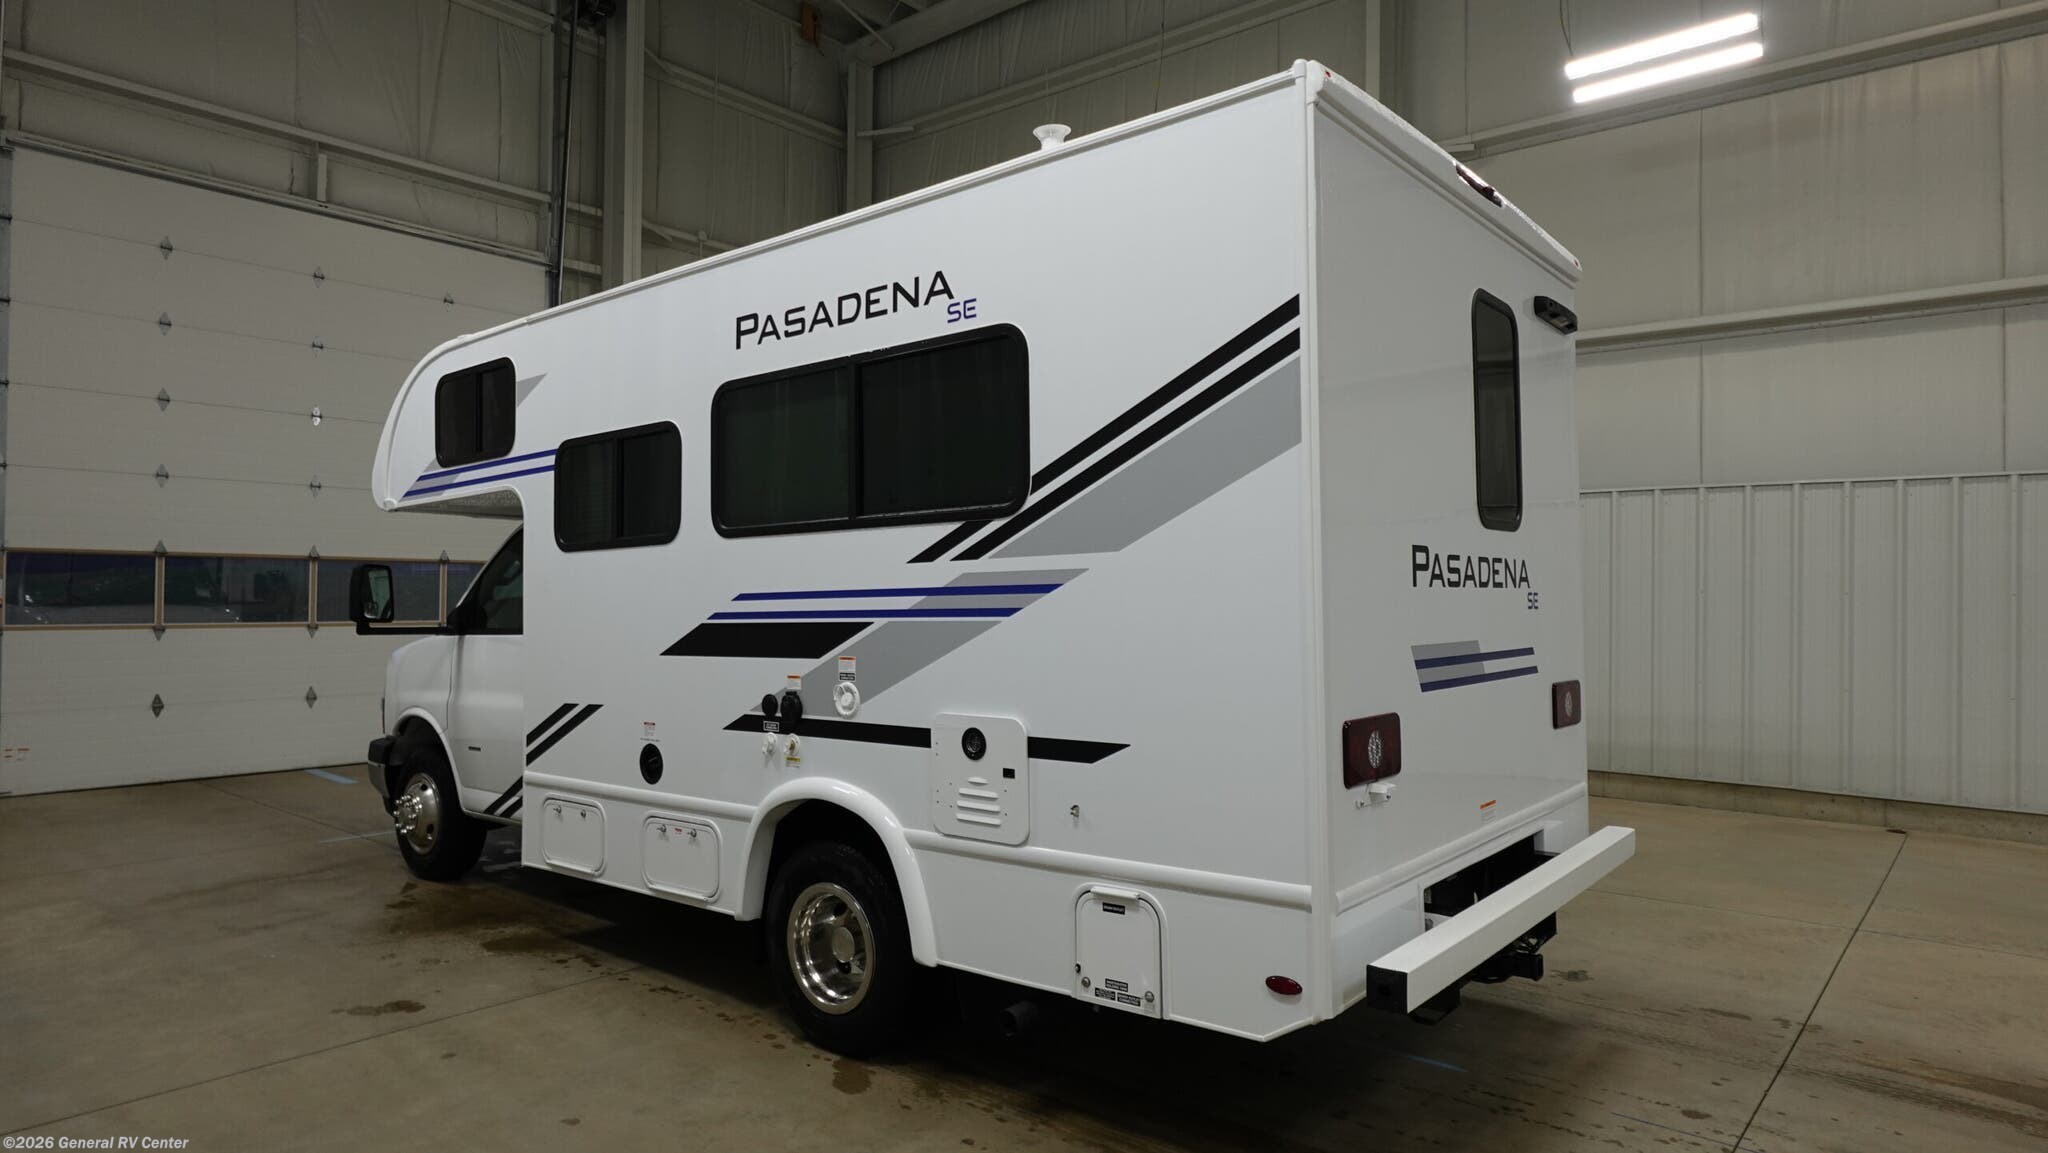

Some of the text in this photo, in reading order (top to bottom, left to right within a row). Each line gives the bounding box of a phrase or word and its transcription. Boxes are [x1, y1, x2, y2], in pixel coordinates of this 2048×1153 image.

[736, 270, 955, 350] PASADENA
[947, 298, 977, 324] SE
[1411, 544, 1531, 589] PASADENA
[1527, 592, 1539, 610] SE
